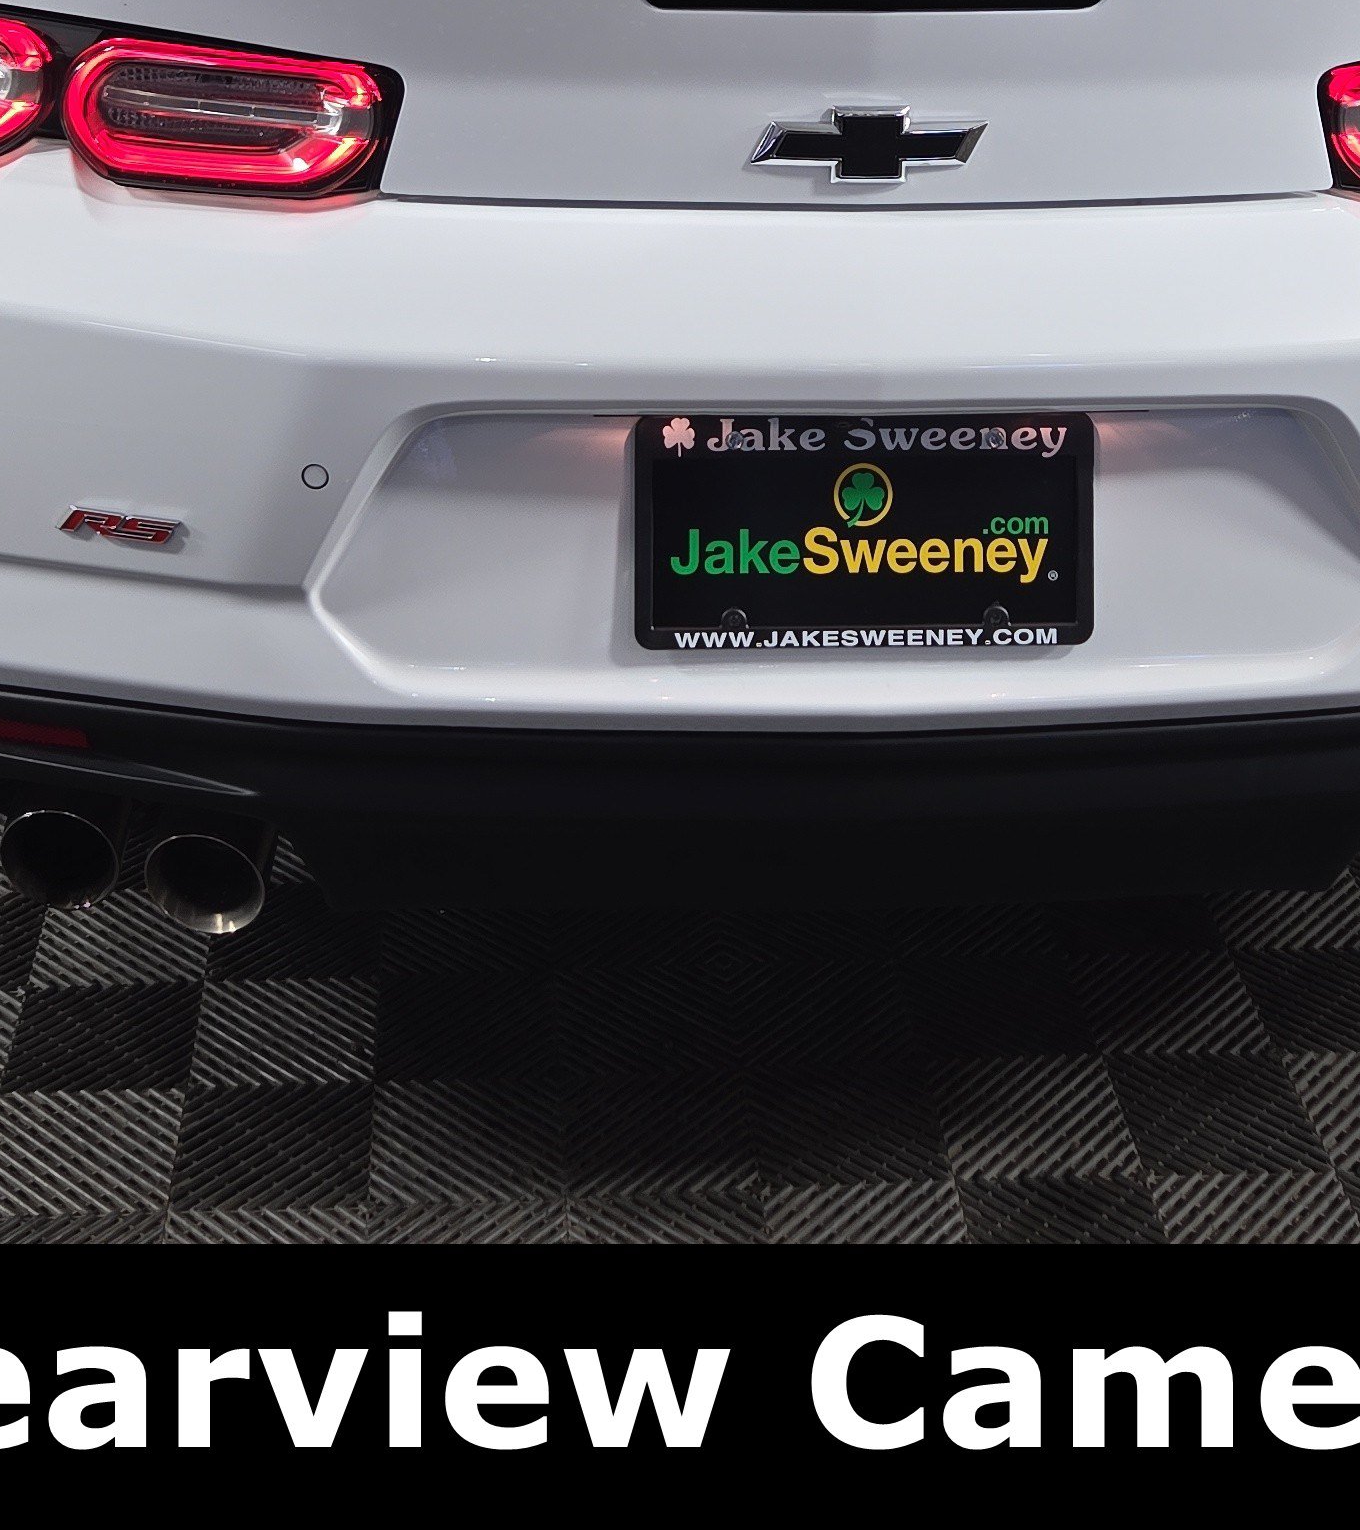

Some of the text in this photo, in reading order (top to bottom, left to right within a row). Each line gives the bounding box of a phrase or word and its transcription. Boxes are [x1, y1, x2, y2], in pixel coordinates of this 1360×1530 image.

[706, 417, 1068, 458] Jake Sweeney
[55, 504, 181, 545] RS
[982, 515, 1049, 536] .com
[675, 628, 1059, 649] WWW.JAKESWEENEY.COM
